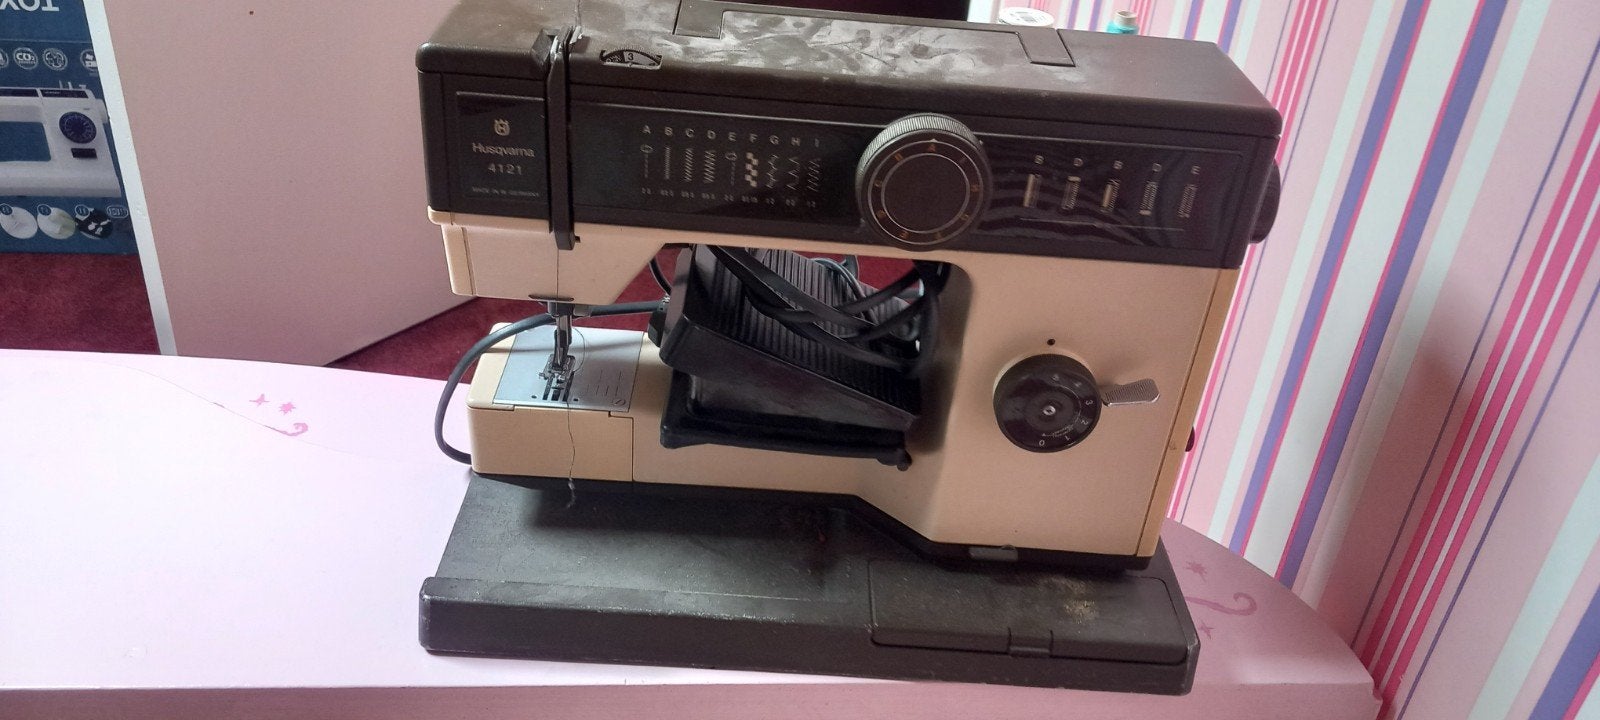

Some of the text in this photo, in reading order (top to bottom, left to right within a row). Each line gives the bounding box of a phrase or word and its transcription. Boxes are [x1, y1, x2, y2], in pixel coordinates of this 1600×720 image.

[627, 52, 635, 61] 3
[642, 124, 651, 134] A
[664, 126, 673, 137] B
[685, 128, 695, 138] C
[707, 130, 716, 140] D
[728, 131, 737, 142] E
[750, 133, 758, 142] F
[769, 135, 780, 145] G
[791, 137, 801, 147] H
[471, 142, 536, 158] Husqvarna
[487, 162, 523, 176] 4121
